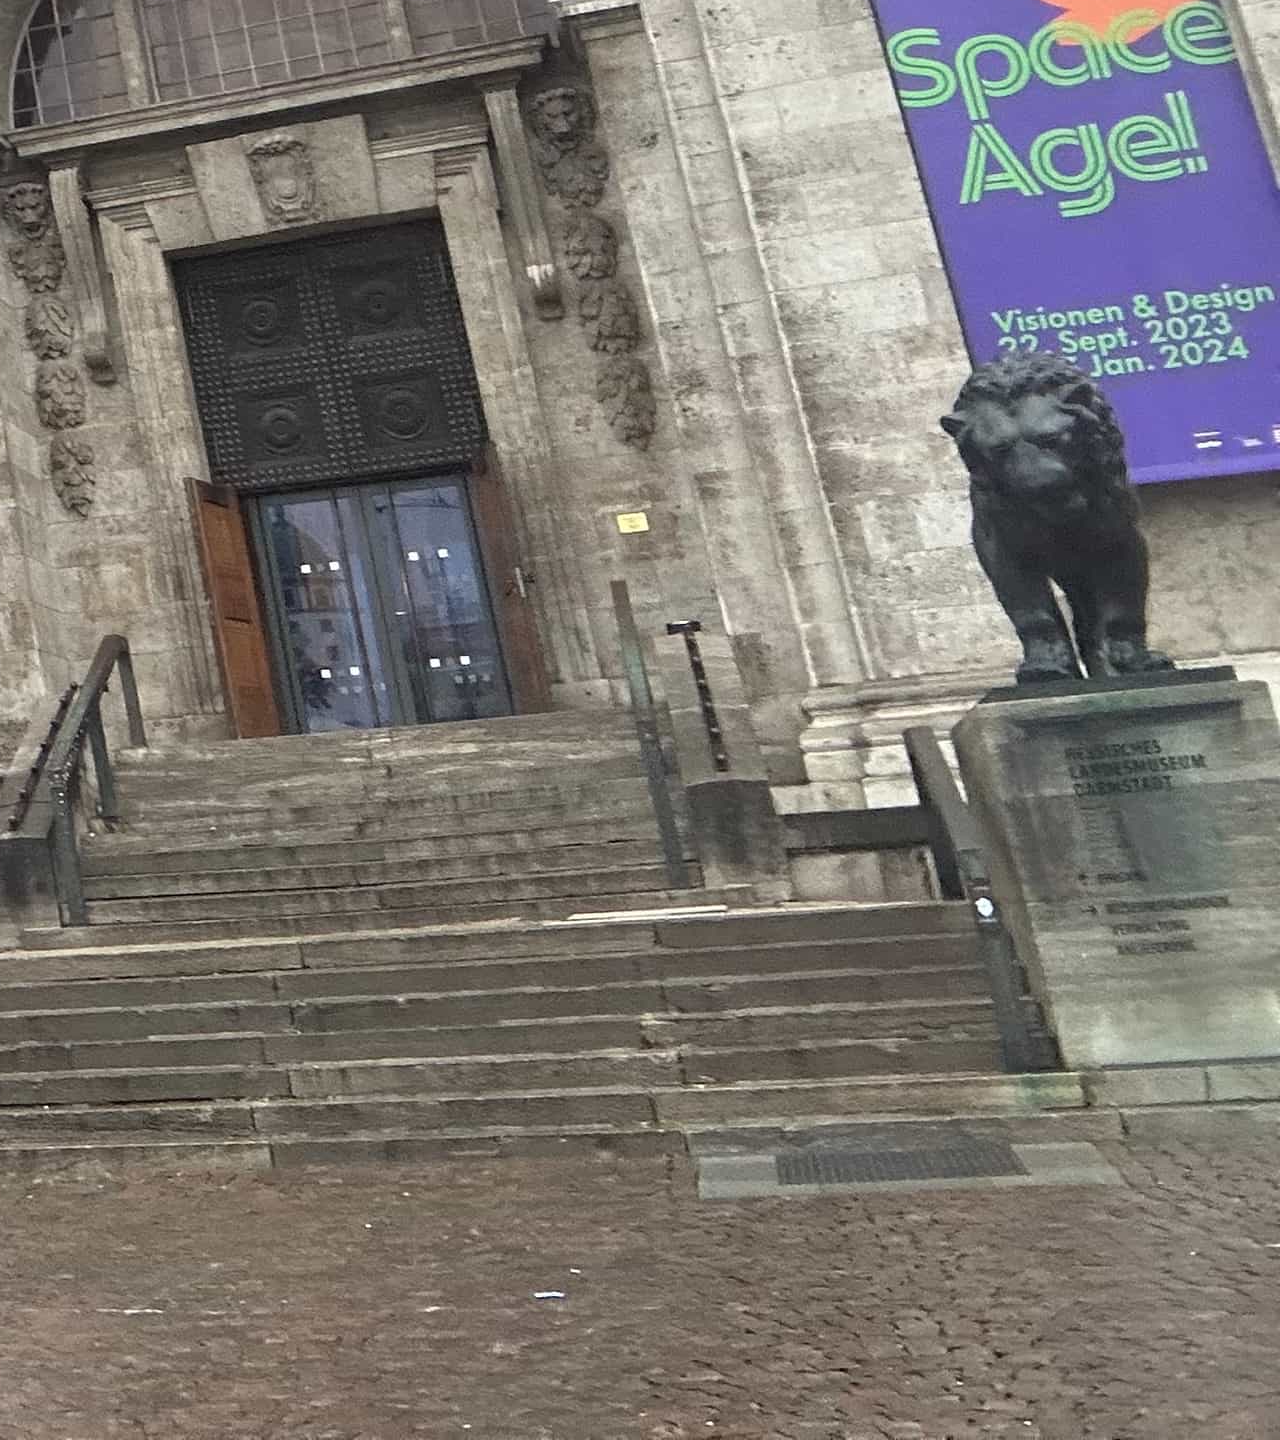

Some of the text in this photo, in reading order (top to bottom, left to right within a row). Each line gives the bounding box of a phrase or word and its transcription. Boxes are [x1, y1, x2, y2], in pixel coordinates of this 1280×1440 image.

[887, 0, 1236, 121] Space
[960, 91, 1209, 217] Age!
[992, 283, 1275, 333] Visionen & Design
[1058, 327, 1138, 356] Sept.
[1144, 311, 1234, 344] 2023
[1090, 354, 1156, 378] Jan.
[1159, 336, 1250, 369] 2024
